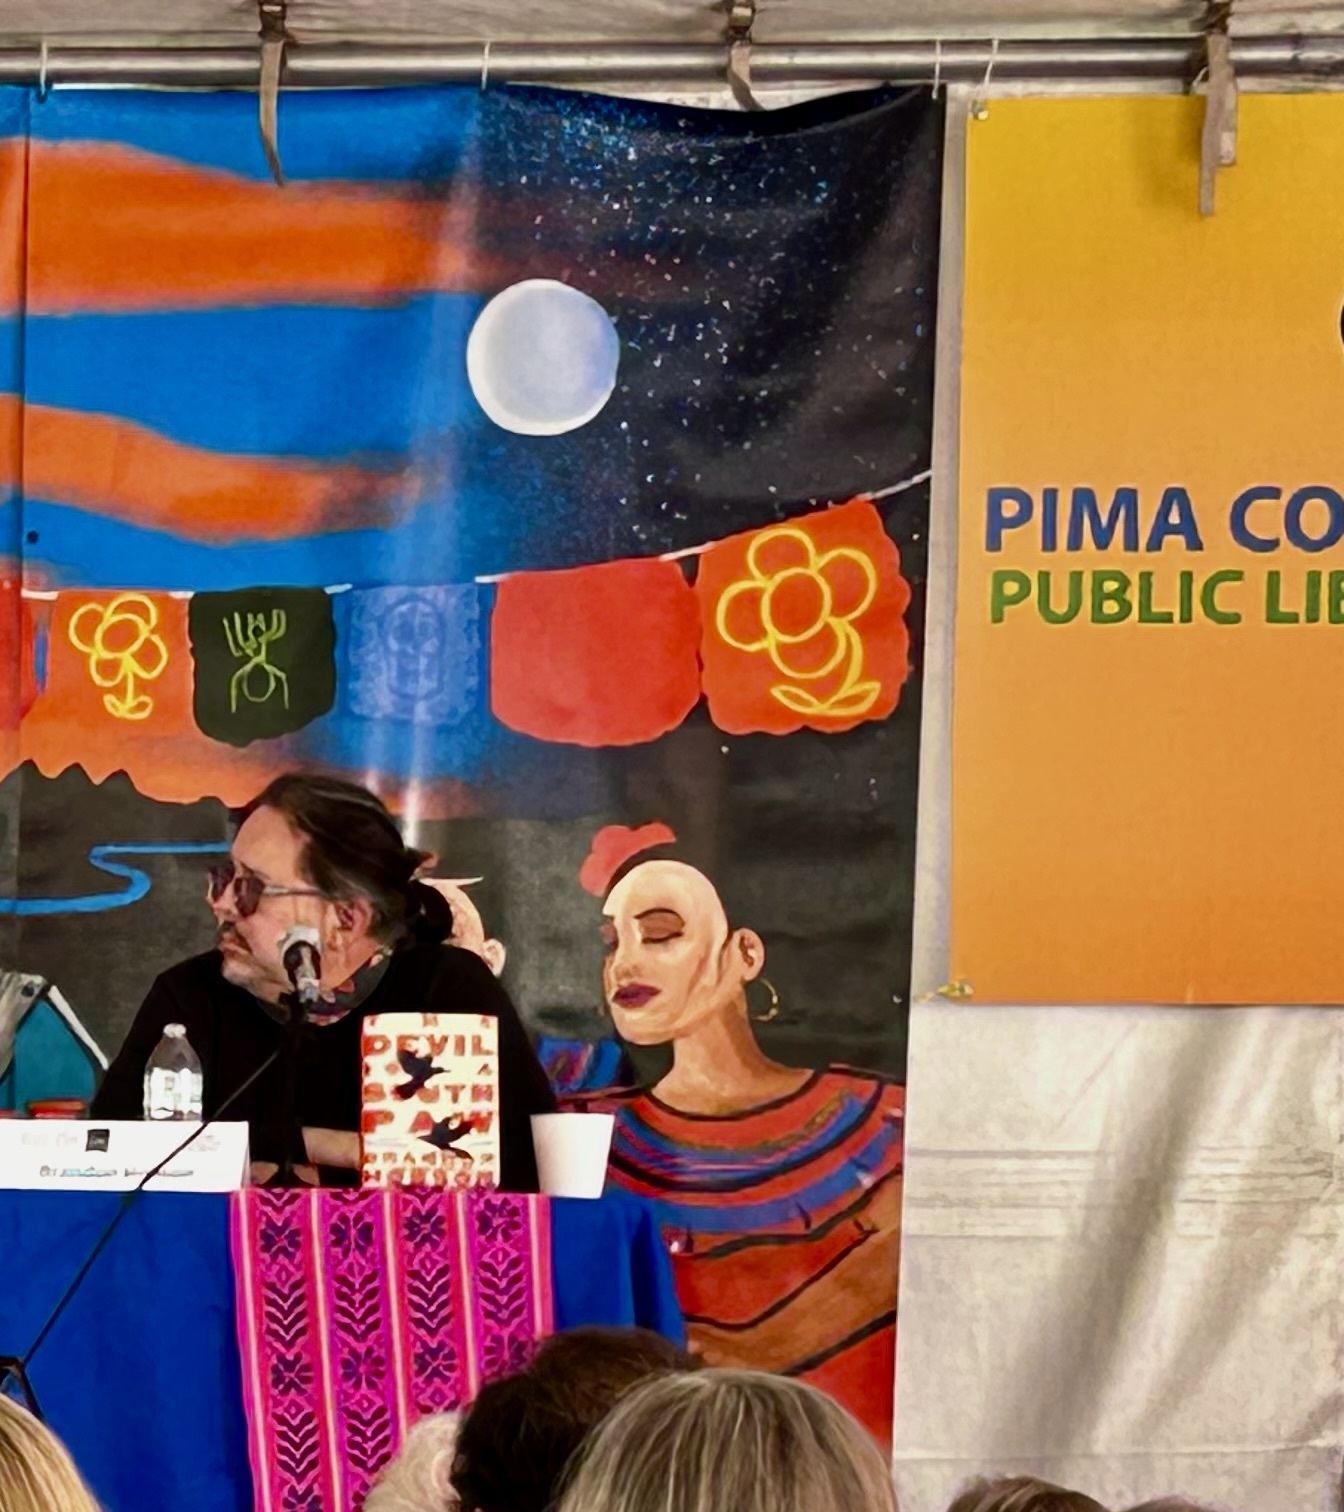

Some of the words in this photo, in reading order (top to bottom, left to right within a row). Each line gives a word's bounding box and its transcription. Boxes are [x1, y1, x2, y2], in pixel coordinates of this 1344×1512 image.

[985, 487, 1204, 552] PIMA
[990, 570, 1245, 624] PUBLIC
[362, 1034, 495, 1056] DEVIL
